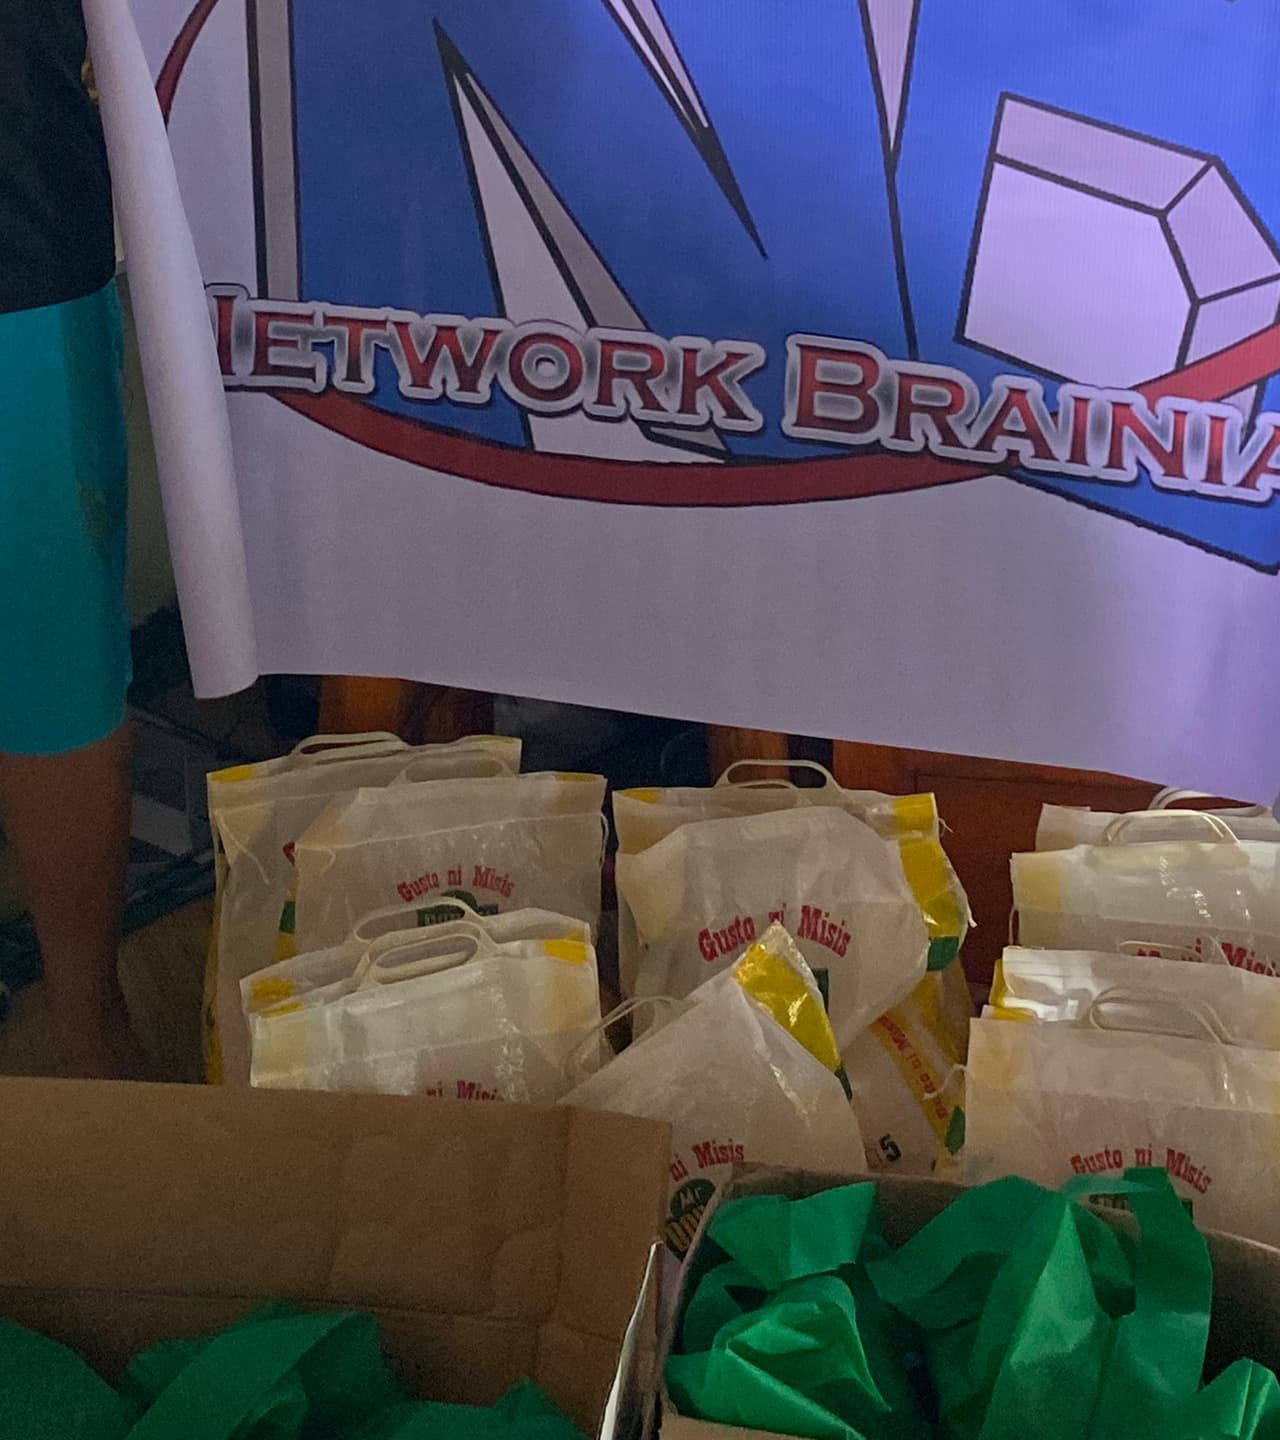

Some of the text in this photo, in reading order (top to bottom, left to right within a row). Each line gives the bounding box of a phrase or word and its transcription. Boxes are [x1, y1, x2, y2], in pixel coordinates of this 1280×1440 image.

[397, 864, 515, 903] Gusto ni Misis
[698, 915, 757, 962] Gusto
[797, 905, 852, 959] Misis
[692, 1138, 745, 1168] Misis
[1071, 1142, 1212, 1194] Gusto ni Misis
